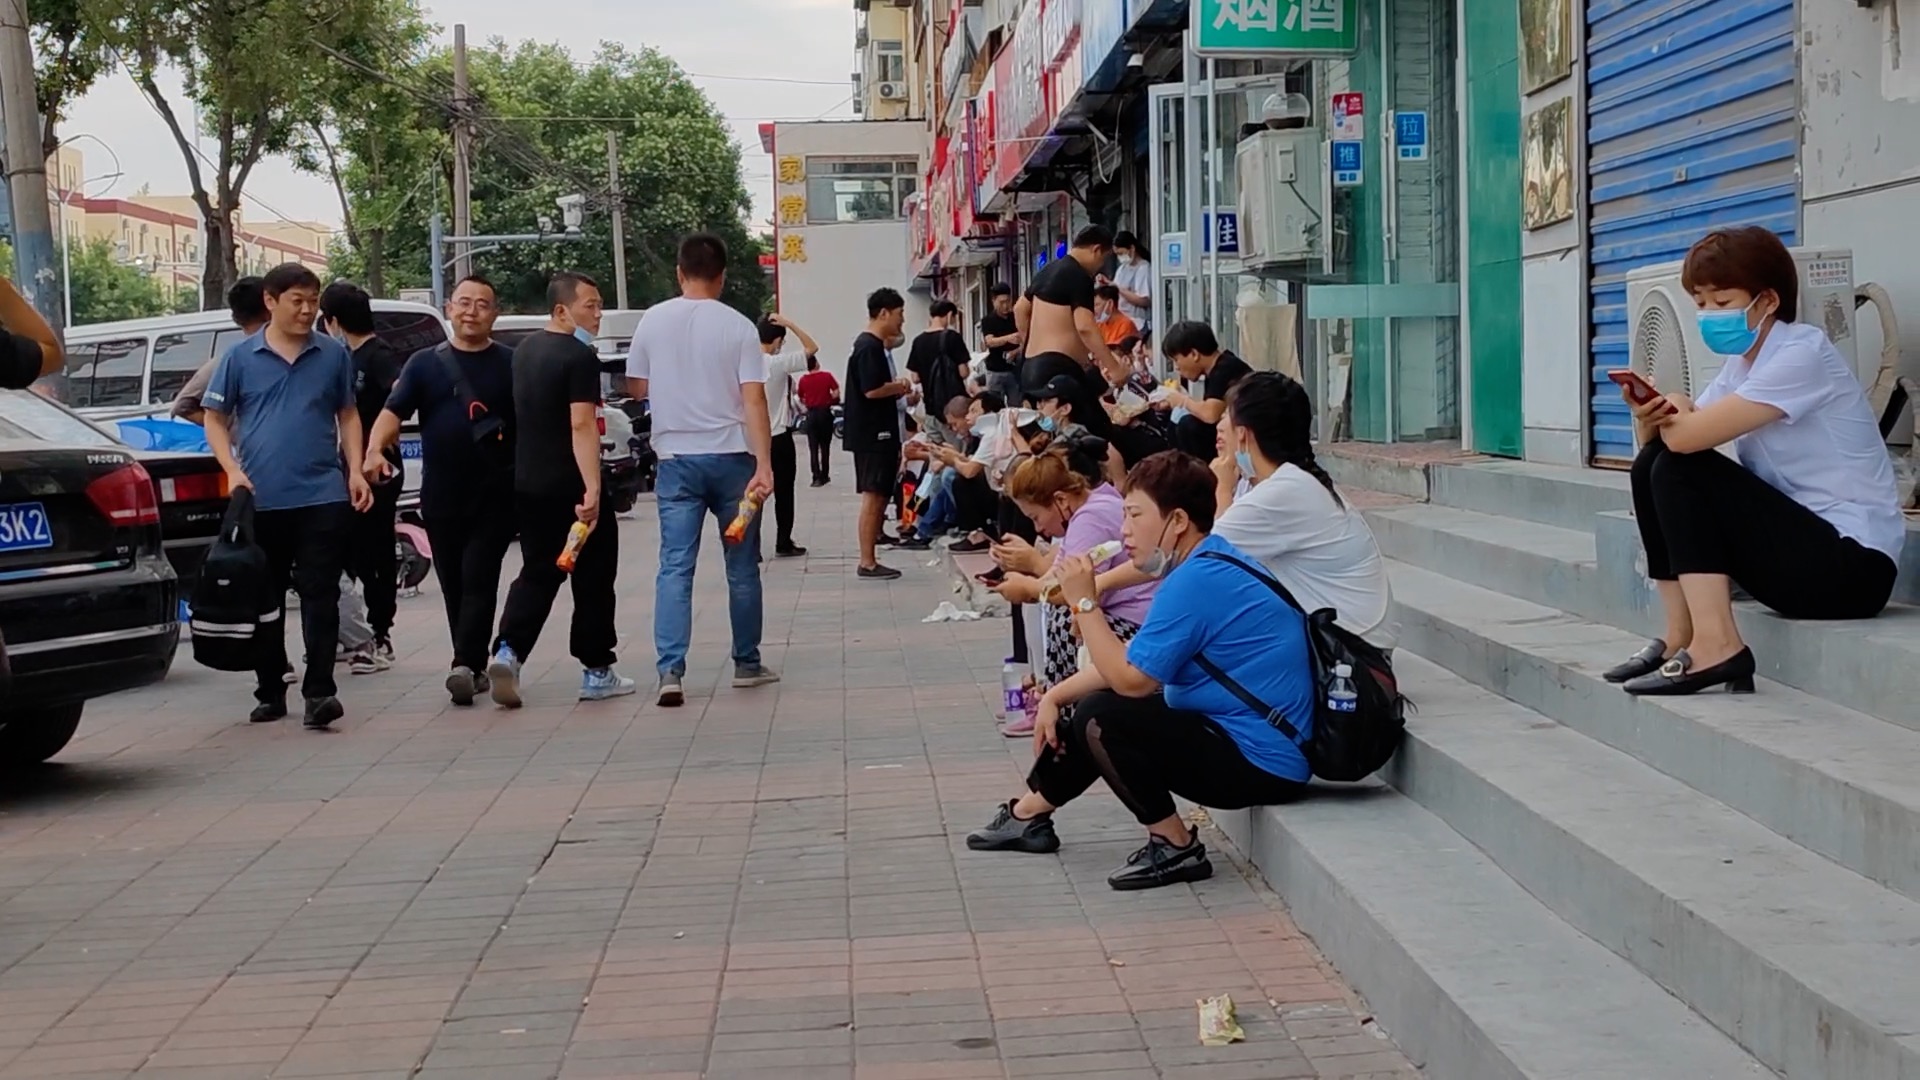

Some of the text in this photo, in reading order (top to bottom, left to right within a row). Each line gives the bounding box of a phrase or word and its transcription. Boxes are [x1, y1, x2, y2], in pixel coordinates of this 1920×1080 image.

[1402, 117, 1419, 136] 拉
[1339, 145, 1356, 162] 推
[778, 155, 808, 263] 家常菜
